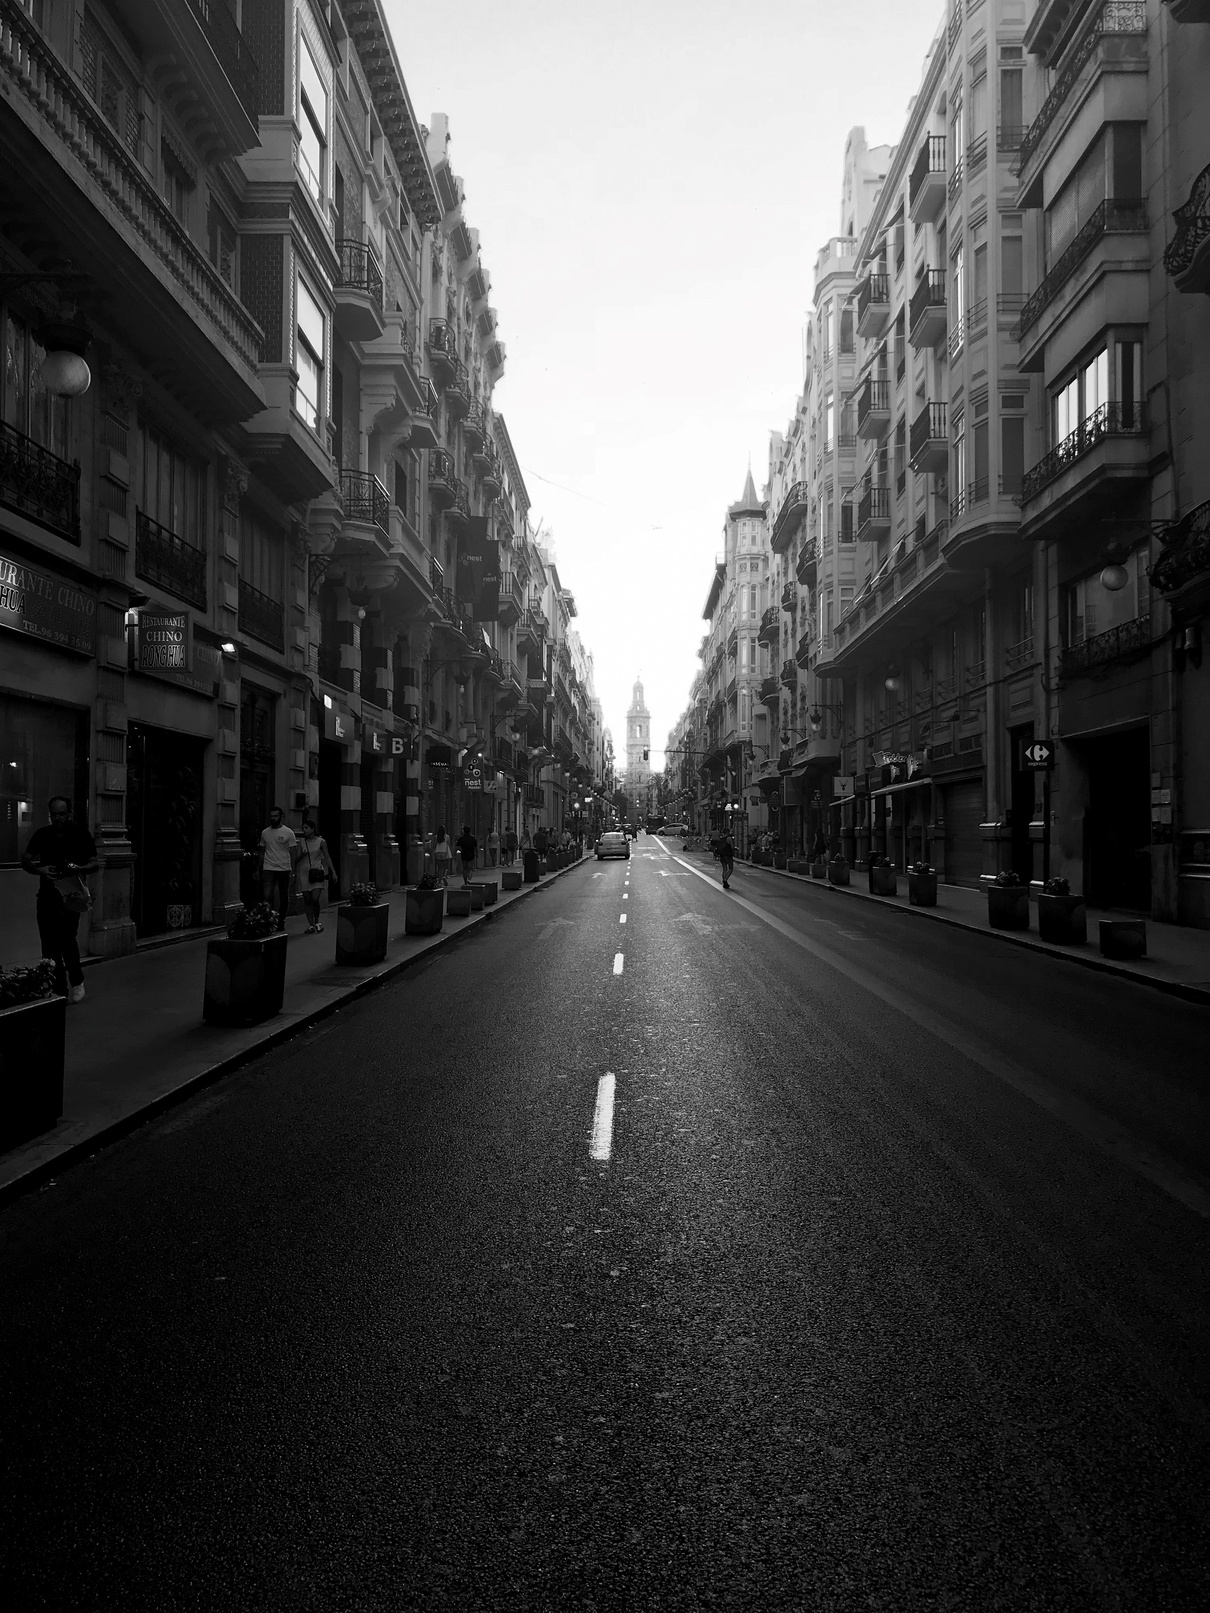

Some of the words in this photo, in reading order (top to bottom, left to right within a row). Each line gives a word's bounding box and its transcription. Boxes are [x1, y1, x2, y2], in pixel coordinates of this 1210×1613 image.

[57, 587, 95, 616] CHINO
[141, 615, 186, 628] RESTAURANTE
[71, 636, 81, 647] 35
[81, 640, 92, 651] 09
[146, 631, 183, 642] CHINO
[142, 644, 167, 668] RONG
[166, 644, 186, 668] HUA
[464, 778, 482, 786] nest
